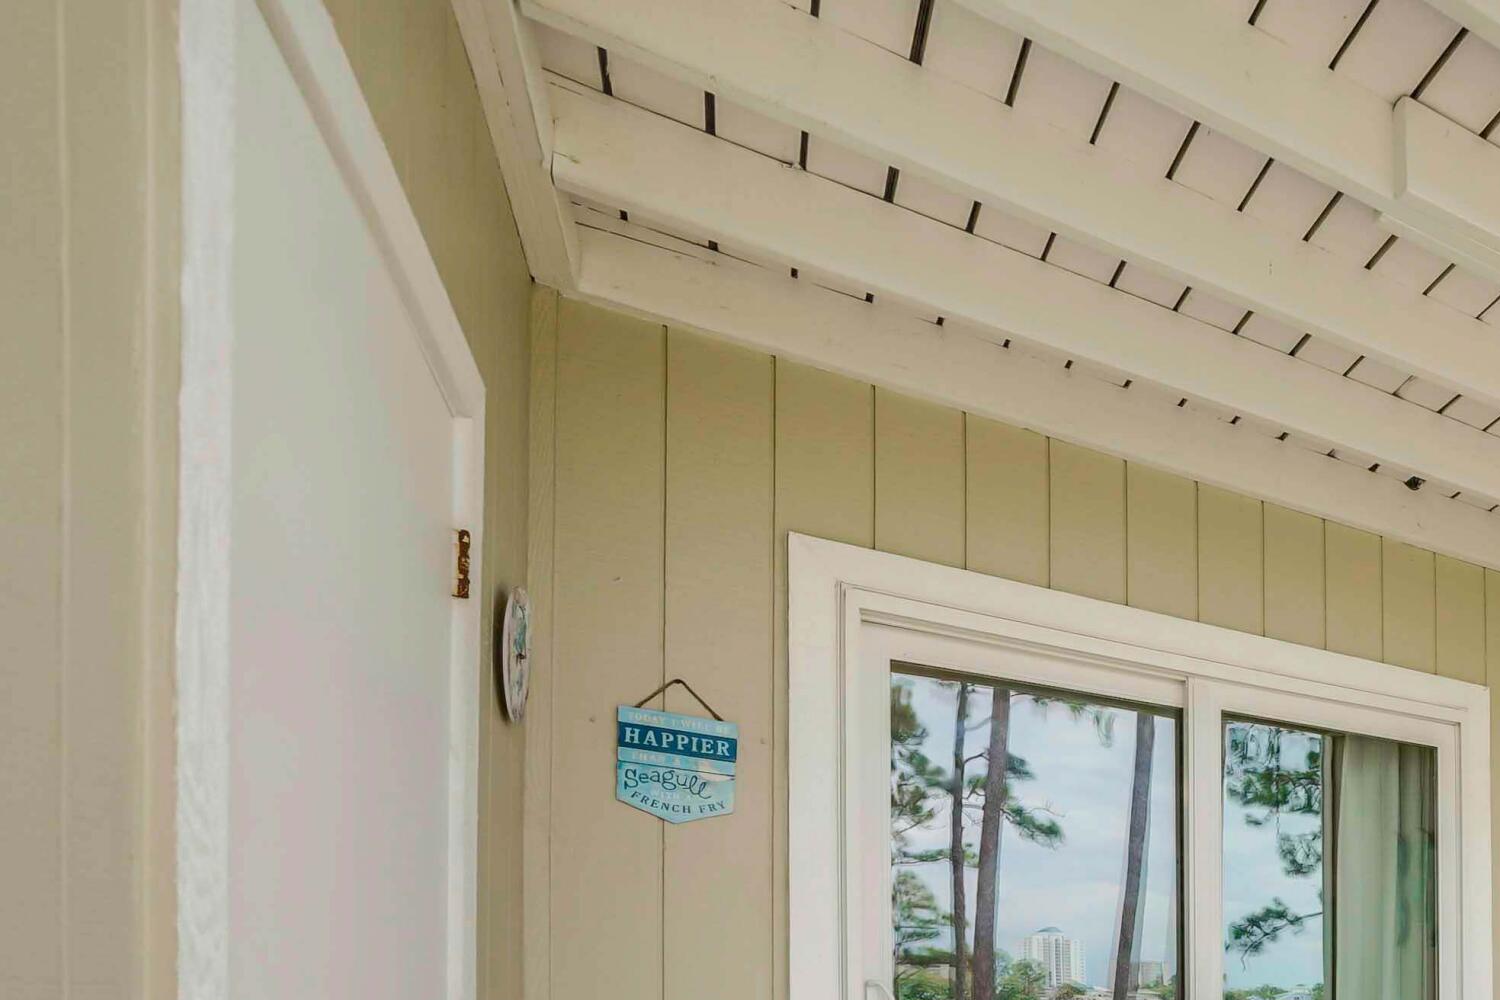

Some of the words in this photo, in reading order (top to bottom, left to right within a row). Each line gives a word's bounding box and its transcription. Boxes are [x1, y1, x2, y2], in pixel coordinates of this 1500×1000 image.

[624, 726, 731, 756] HAPPIER
[623, 768, 712, 799] Seagull
[630, 791, 692, 814] FRENCH
[698, 800, 727, 814] FRY
